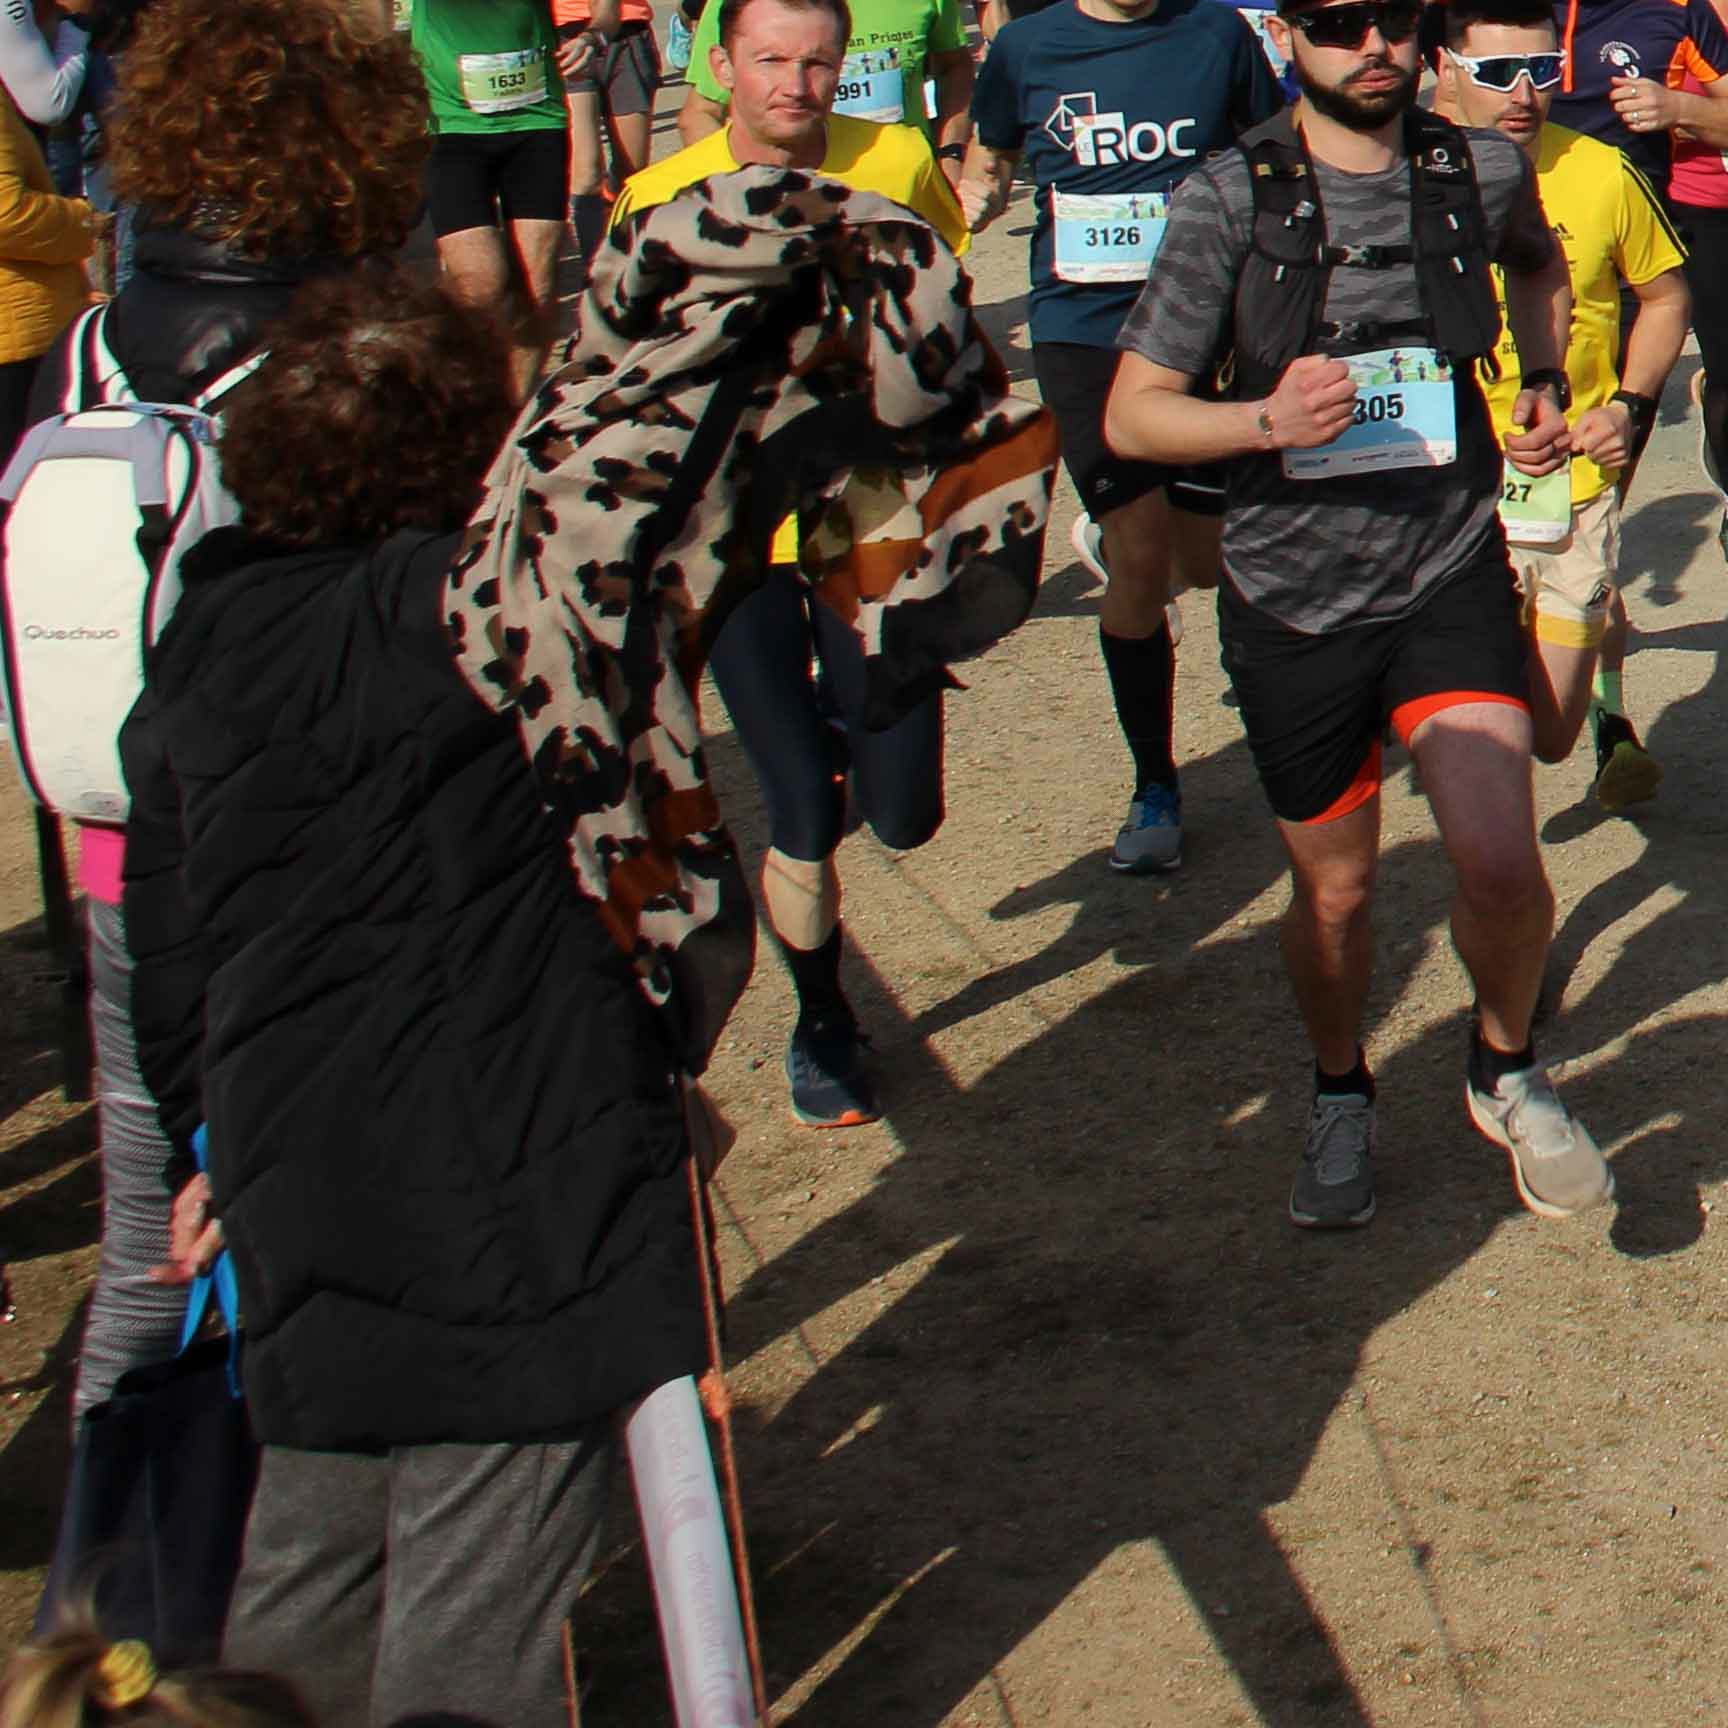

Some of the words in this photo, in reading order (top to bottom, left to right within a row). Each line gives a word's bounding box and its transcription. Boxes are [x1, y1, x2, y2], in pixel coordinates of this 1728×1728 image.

[489, 72, 526, 89] 1633
[1086, 225, 1141, 246] 3126
[1354, 393, 1404, 425] 305
[24, 625, 120, 641] Quechua
